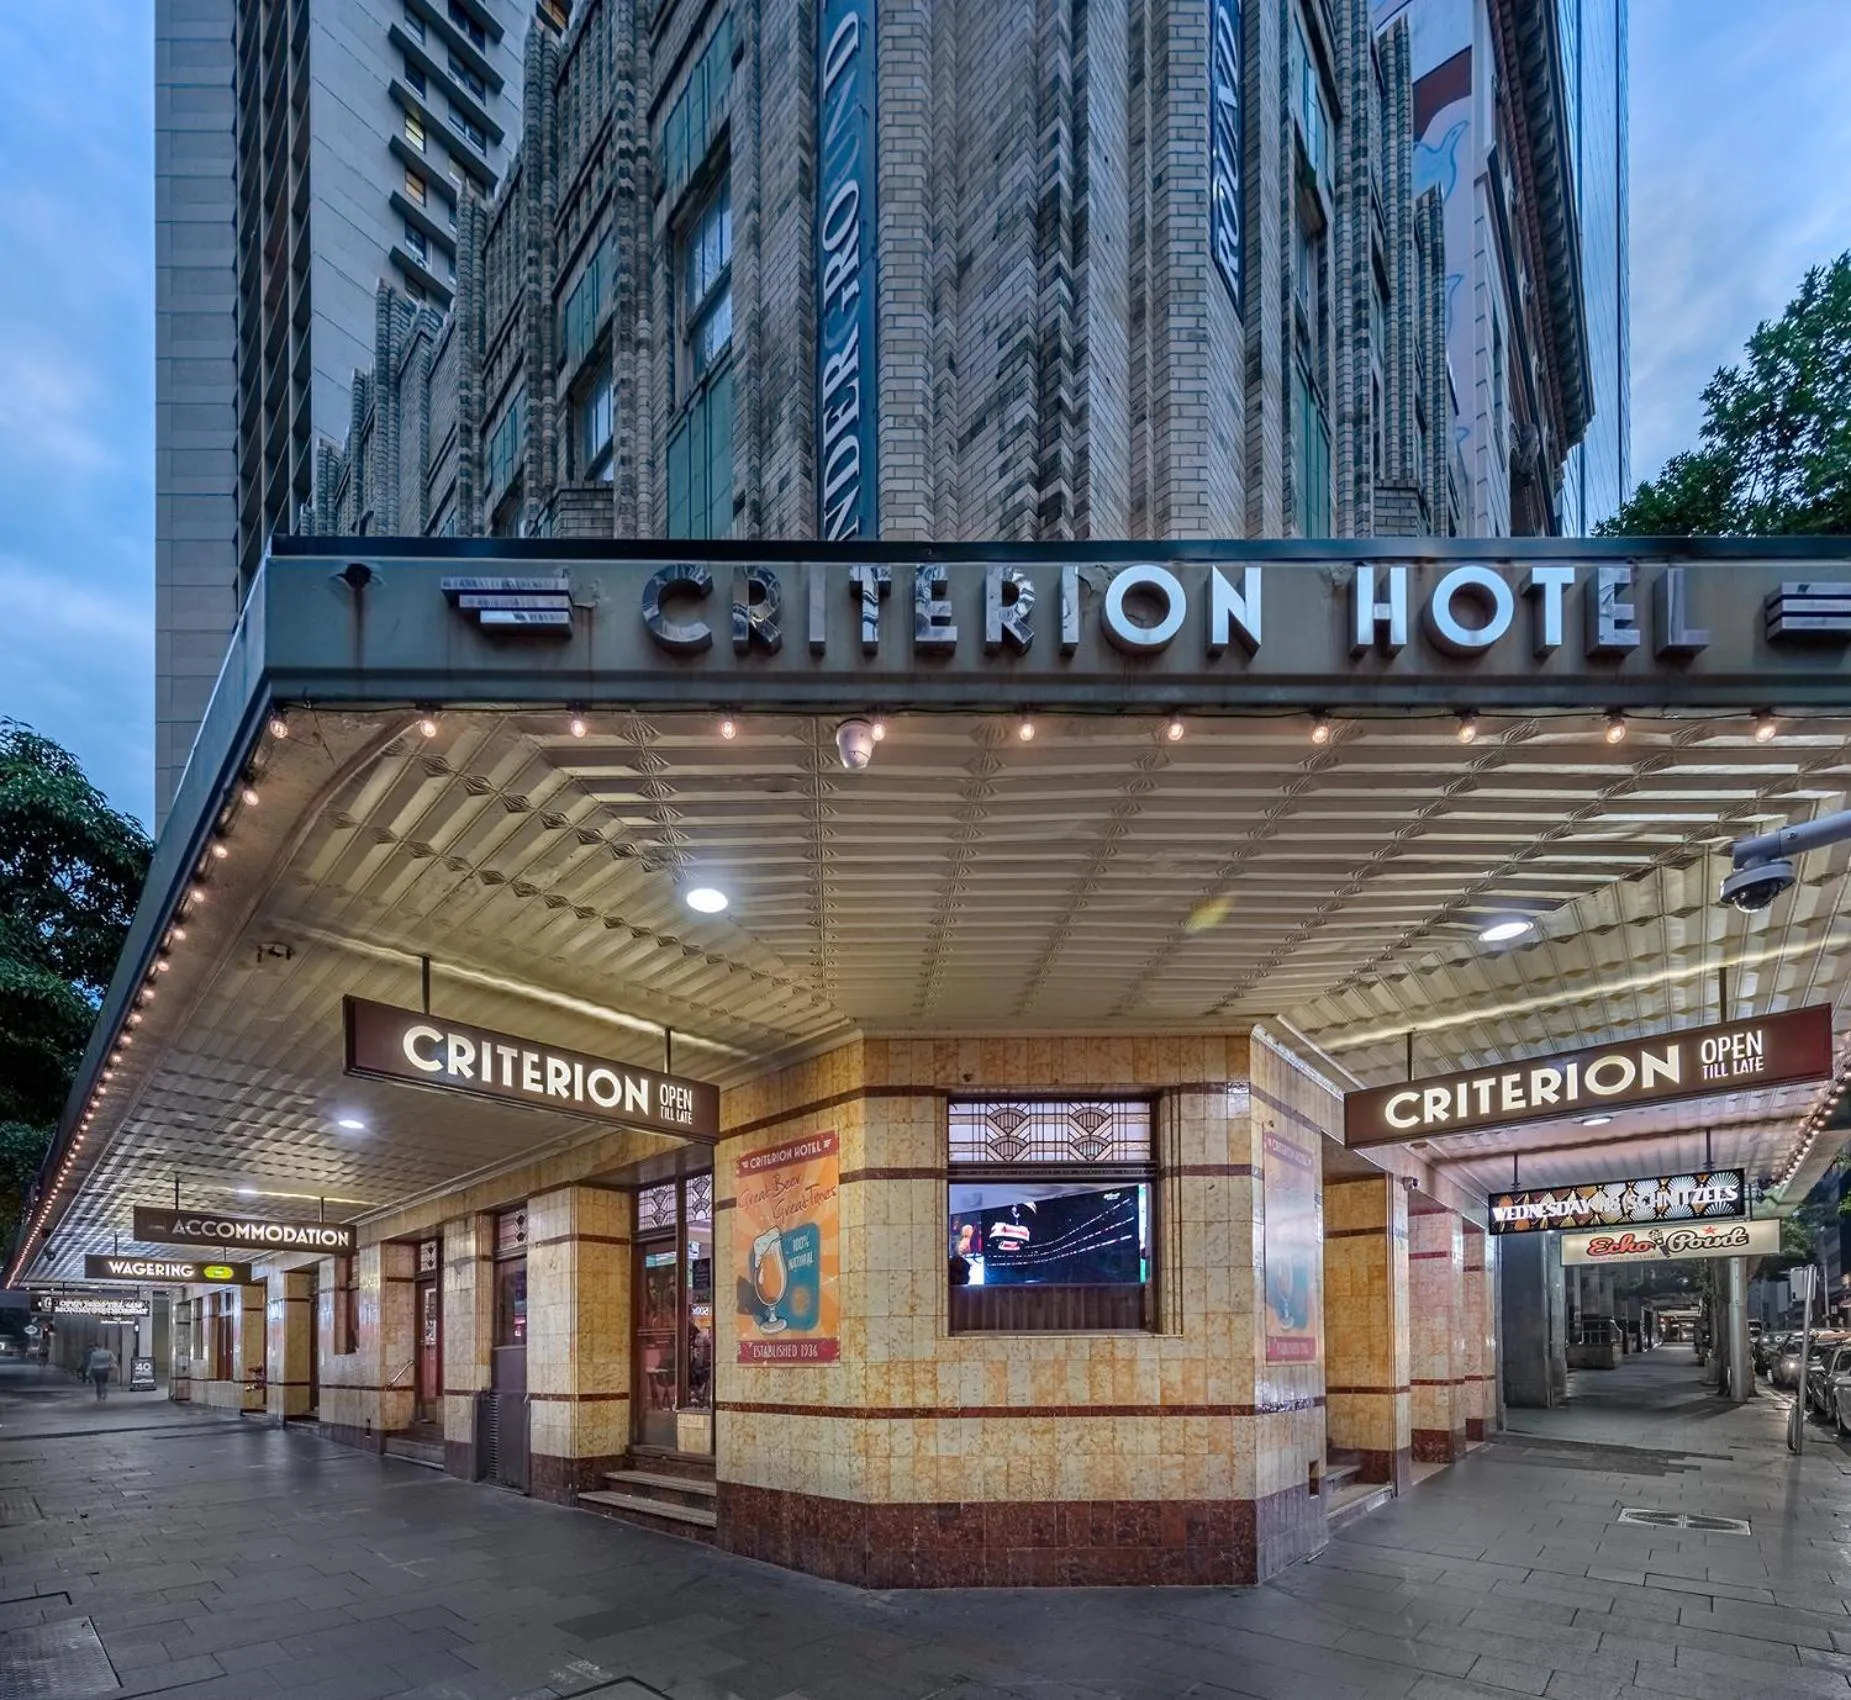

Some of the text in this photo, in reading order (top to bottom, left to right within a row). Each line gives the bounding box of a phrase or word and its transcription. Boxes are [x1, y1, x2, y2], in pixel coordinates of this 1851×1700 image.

[641, 563, 1710, 656] CRITERION HOTEL
[402, 1024, 692, 1116] CRITERION OPEN
[1384, 1029, 1763, 1129] CRITERION OPEN
[1702, 1056, 1764, 1080] TILL LATE
[660, 1106, 692, 1125] TILL LATE
[749, 1140, 822, 1169] CRITERION HOTEL
[1492, 1199, 1591, 1222] WEDNESDAY
[1625, 1185, 1738, 1211] SCHNITZELS
[172, 1218, 349, 1246] ACCOMMODATION
[1586, 1226, 1749, 1257] Echo Point
[108, 1261, 195, 1277] WAGERING
[753, 1343, 818, 1358] ESTABLISHED 1936
